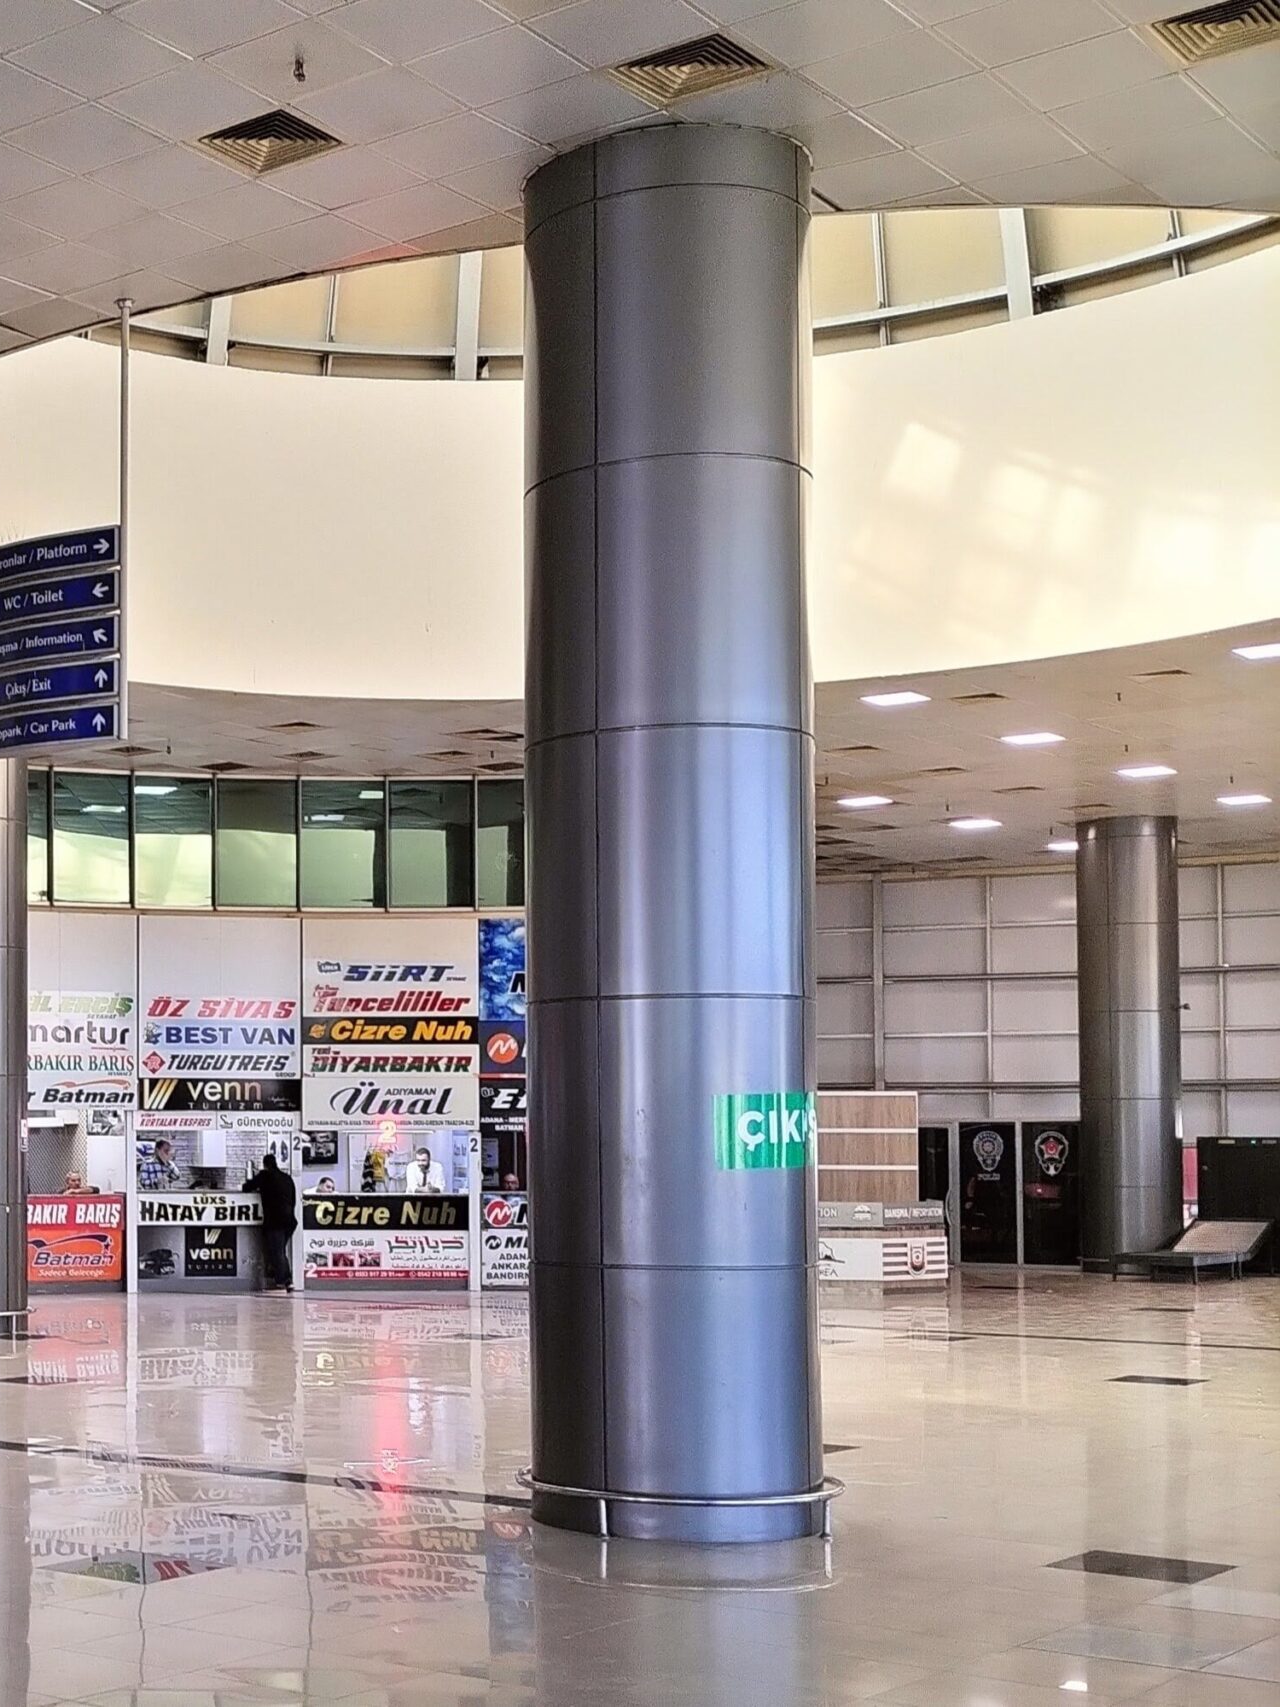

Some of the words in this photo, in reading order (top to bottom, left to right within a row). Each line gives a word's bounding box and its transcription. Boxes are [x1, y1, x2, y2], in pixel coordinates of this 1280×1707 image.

[36, 543, 87, 562] Platform
[4, 596, 21, 611] WC
[31, 589, 63, 606] Toilet
[25, 631, 83, 648] Information
[30, 721, 48, 735] Car
[51, 718, 76, 732] Park
[147, 996, 190, 1017] ÖZ
[197, 997, 297, 1018] SİVAS
[165, 1026, 233, 1044] BEST
[240, 1027, 295, 1045] VAN
[331, 1019, 407, 1041] Cizre
[412, 1020, 473, 1041] Nuh
[42, 1088, 135, 1104] Batman
[186, 1081, 262, 1101] venn
[329, 1081, 453, 1115] Ünal
[385, 1088, 437, 1096] ADIYAMAN
[179, 1117, 212, 1127] EKSPRES
[293, 1136, 300, 1150] 2
[470, 1138, 478, 1152] 2
[139, 1200, 208, 1222] HATAY
[315, 1201, 390, 1226] Cizre
[400, 1201, 456, 1226] Nuh
[33, 1251, 114, 1266] Batman
[189, 1247, 233, 1260] venn
